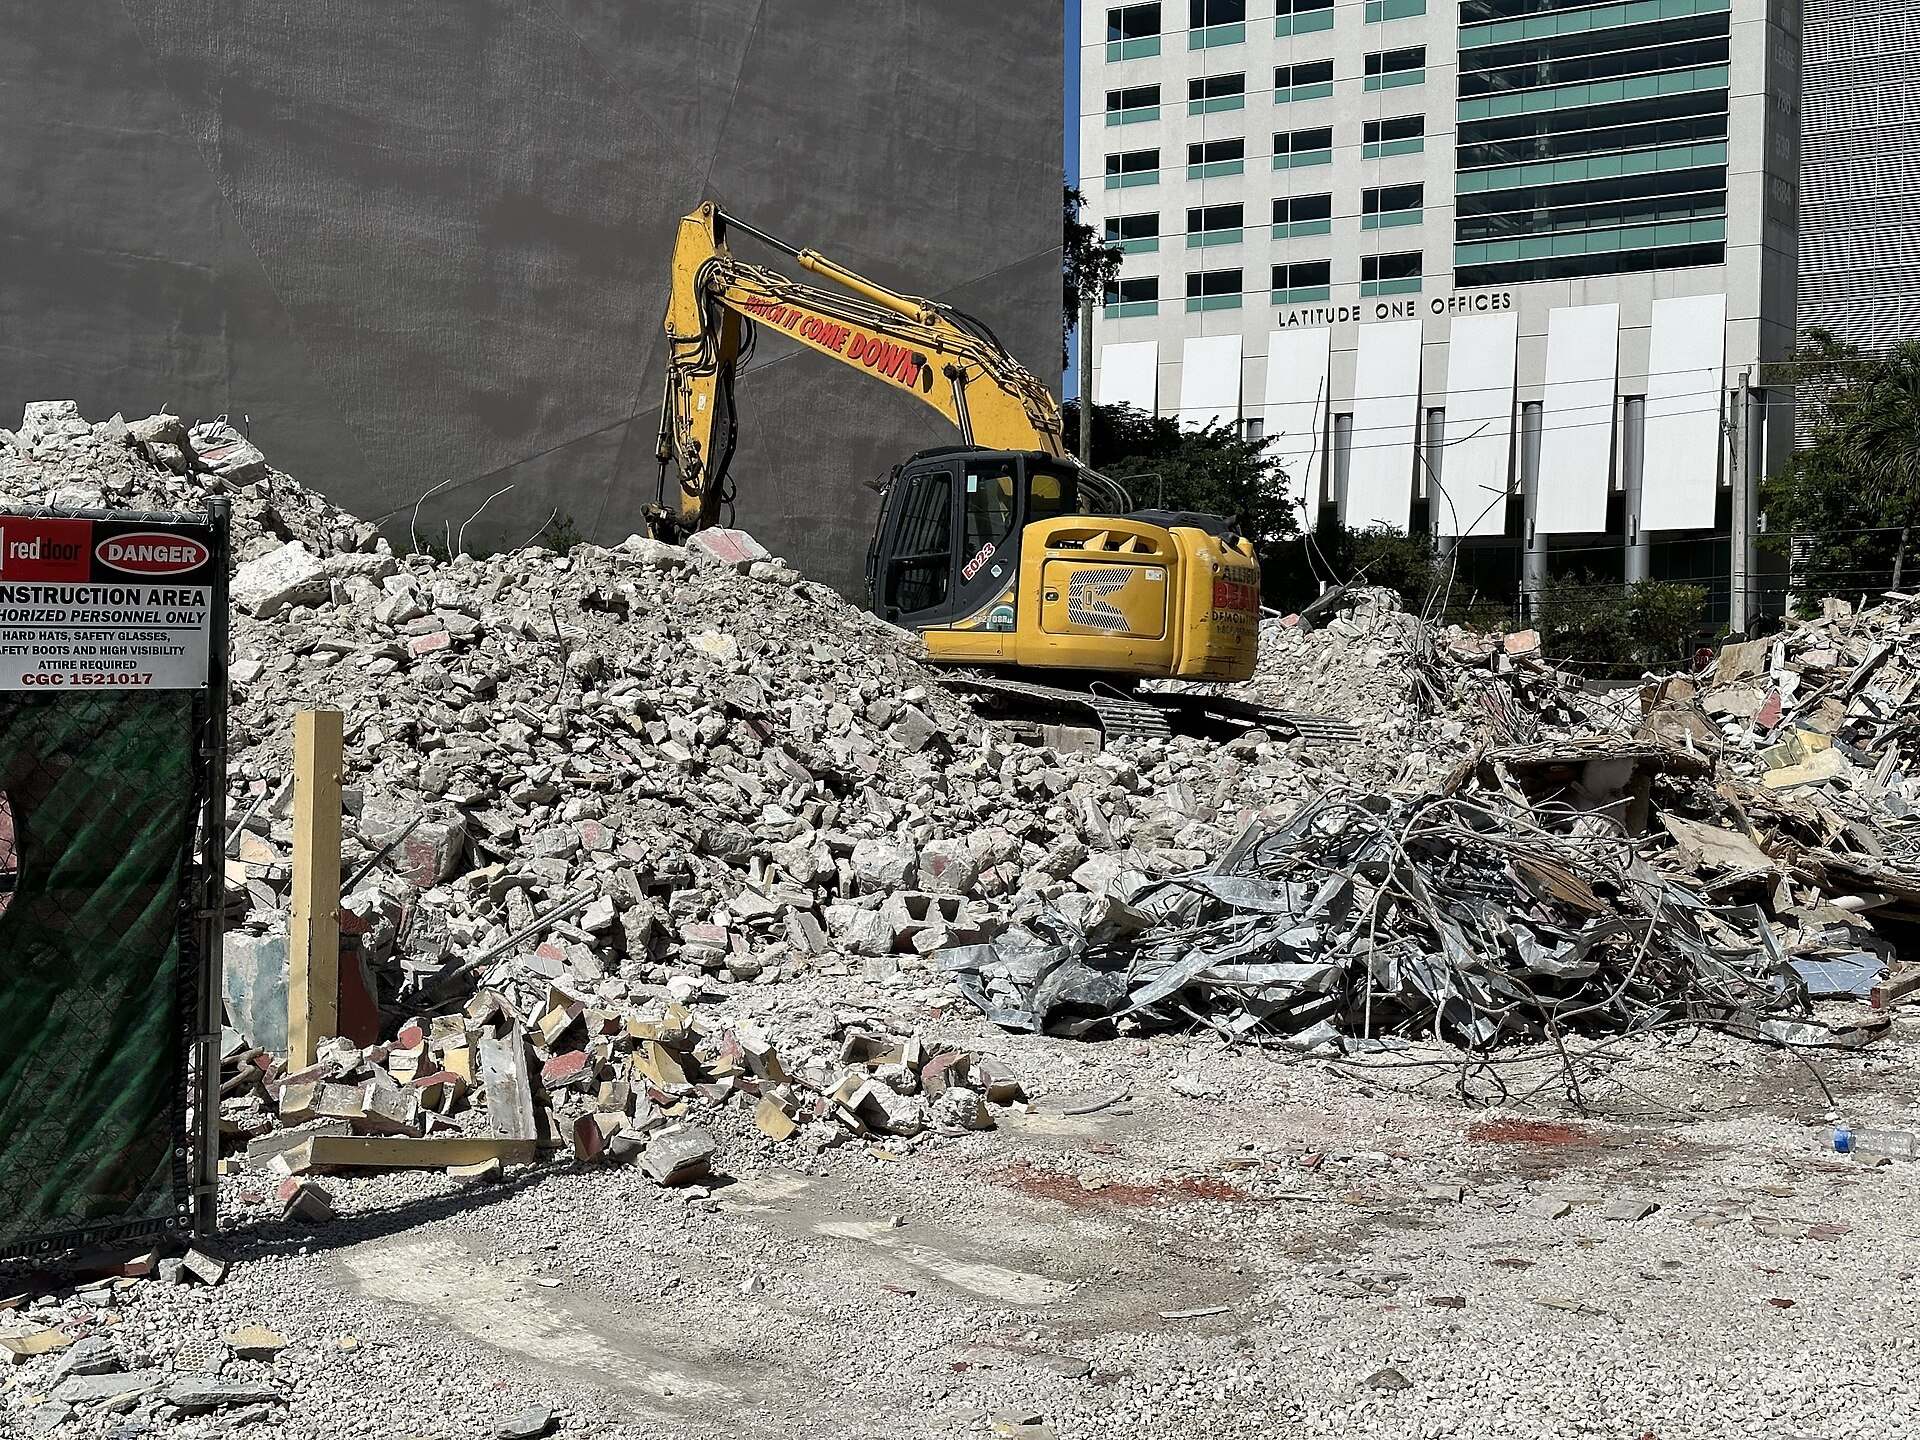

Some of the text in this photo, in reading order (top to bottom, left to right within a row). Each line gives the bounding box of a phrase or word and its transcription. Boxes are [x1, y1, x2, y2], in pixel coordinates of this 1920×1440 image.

[1278, 292, 1511, 327] LATITUDE ONE OFFICES
[782, 309, 803, 330] IT
[799, 315, 851, 353] COME
[847, 332, 923, 388] DOWN
[10, 537, 82, 560] reddoor
[108, 544, 197, 563] DANGER
[147, 589, 206, 607] AREA
[70, 610, 162, 623] PERSONNEL
[166, 611, 206, 624] ONLY
[3, 631, 171, 643] HARD HATS, SAFETY GLASSES,
[32, 646, 70, 655] BOOTS
[73, 646, 97, 655] AND
[100, 646, 128, 655] HIGH
[130, 646, 185, 656] VISIBILITY
[38, 660, 137, 671] ATTIRE REQUIRED
[22, 673, 153, 685] CGC 1521017
